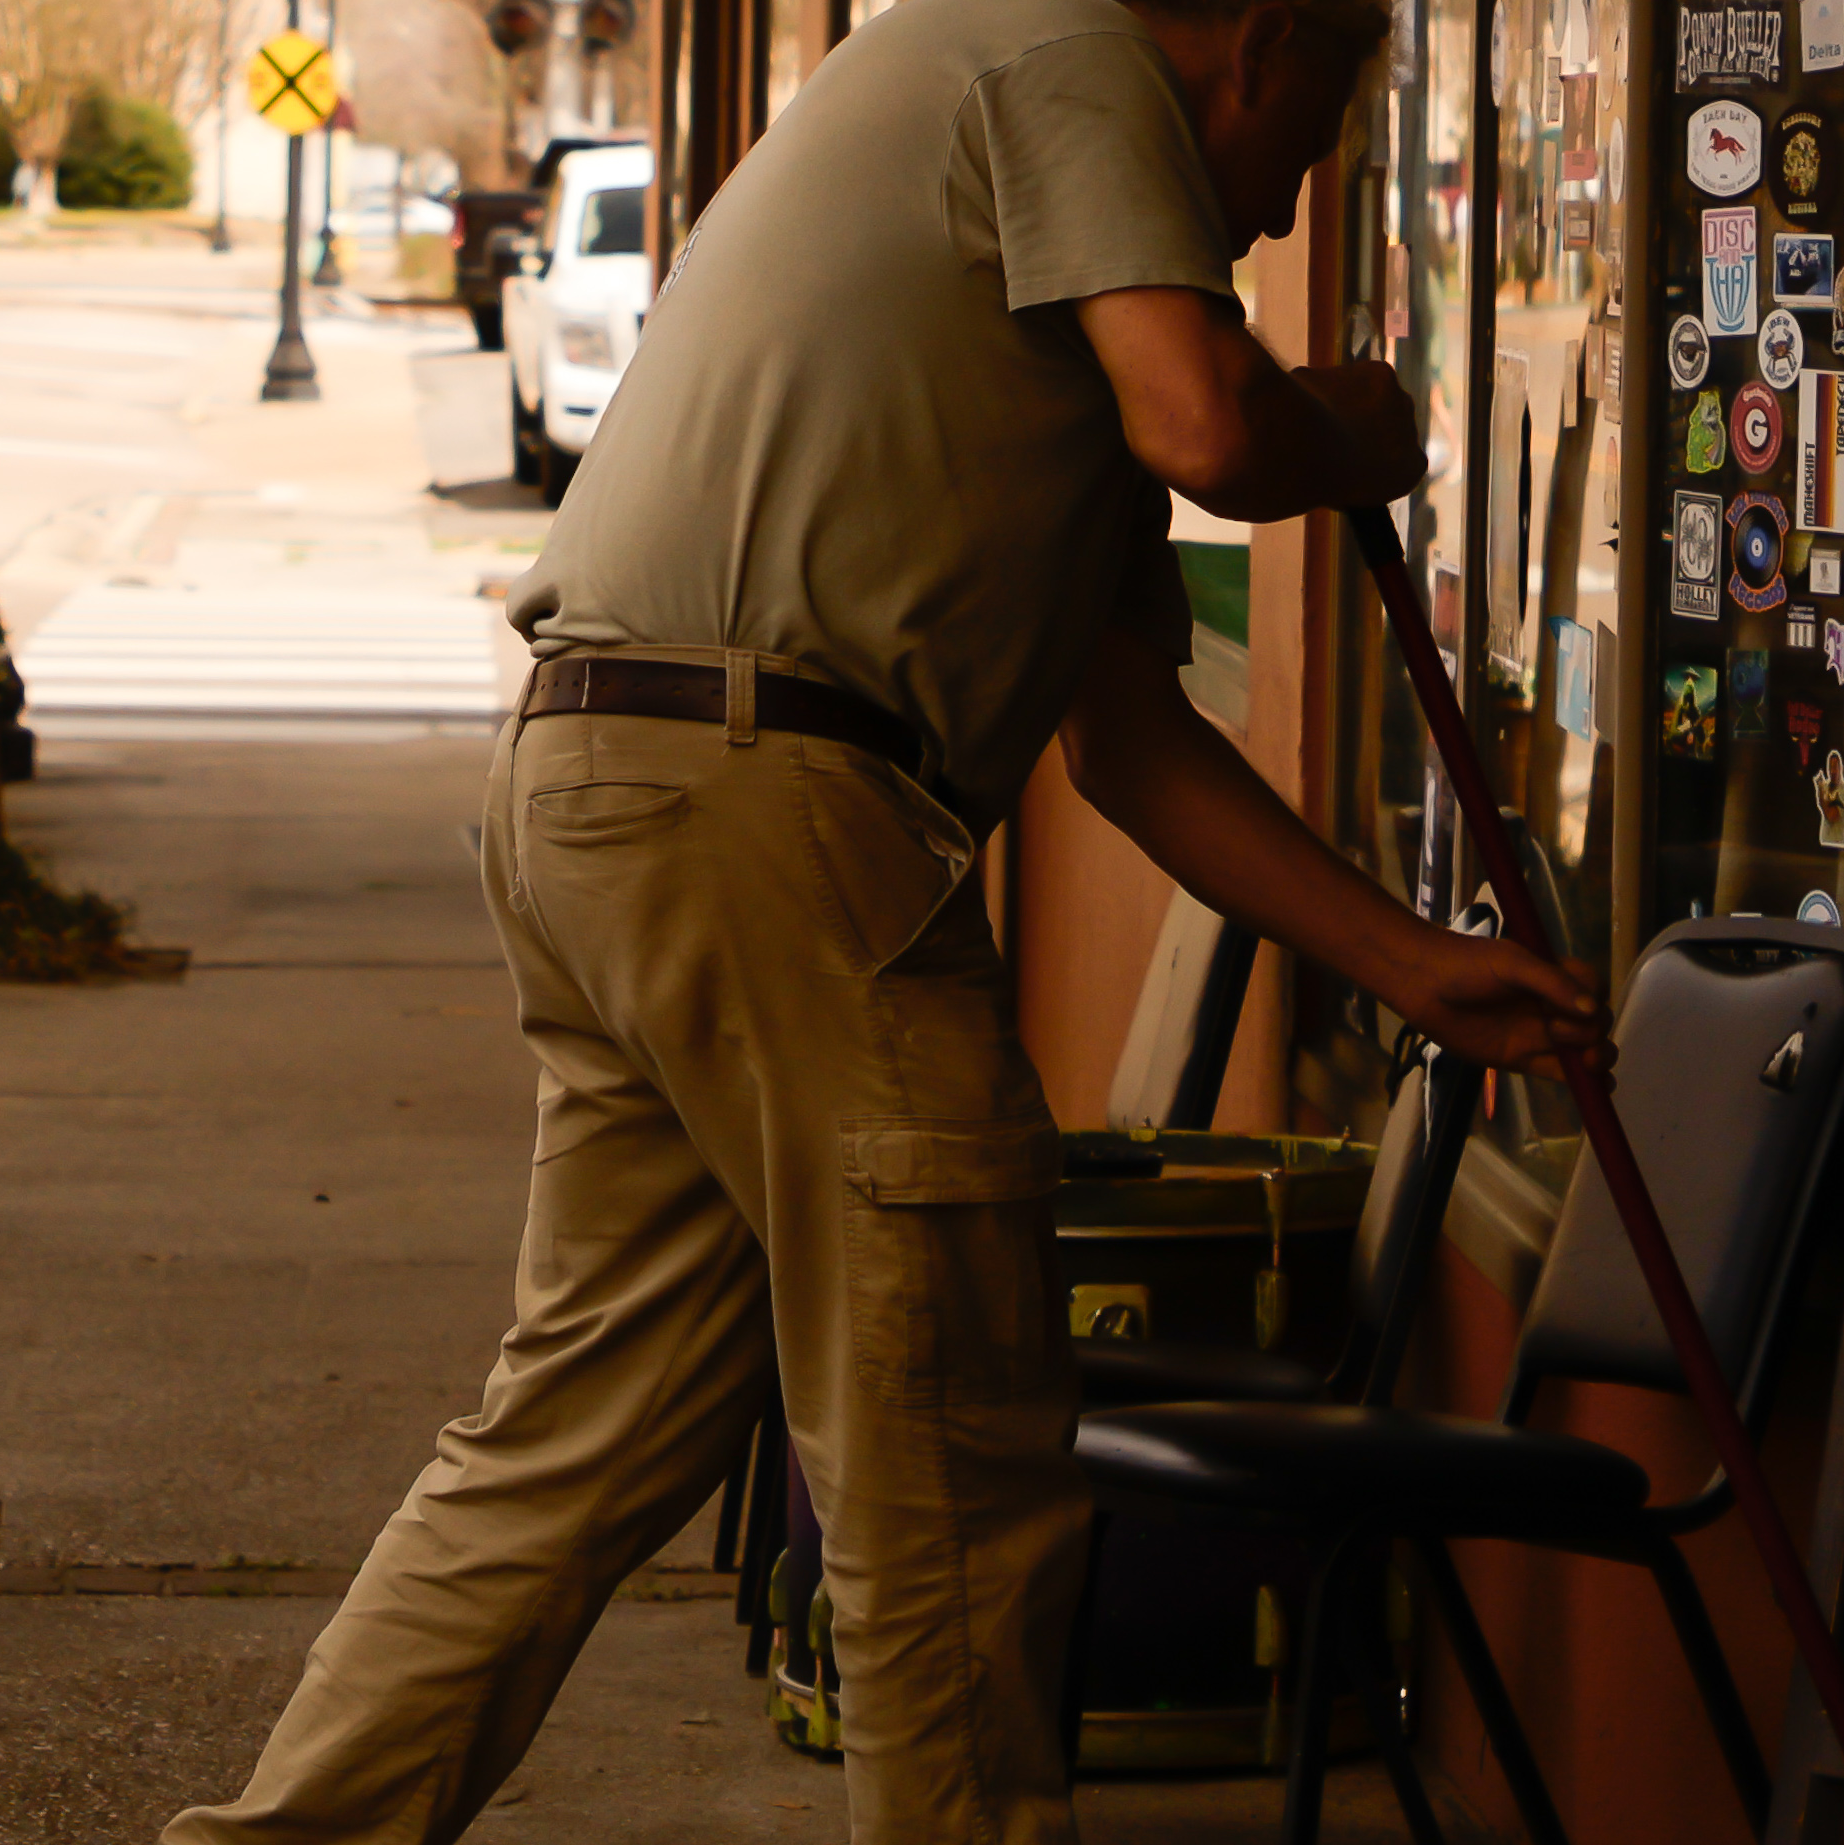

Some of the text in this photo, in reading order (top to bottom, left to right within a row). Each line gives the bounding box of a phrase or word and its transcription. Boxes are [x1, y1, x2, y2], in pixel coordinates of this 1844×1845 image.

[1808, 43, 1842, 60] Delta
[1704, 218, 1754, 256] DISC
[1745, 408, 1768, 448] G
